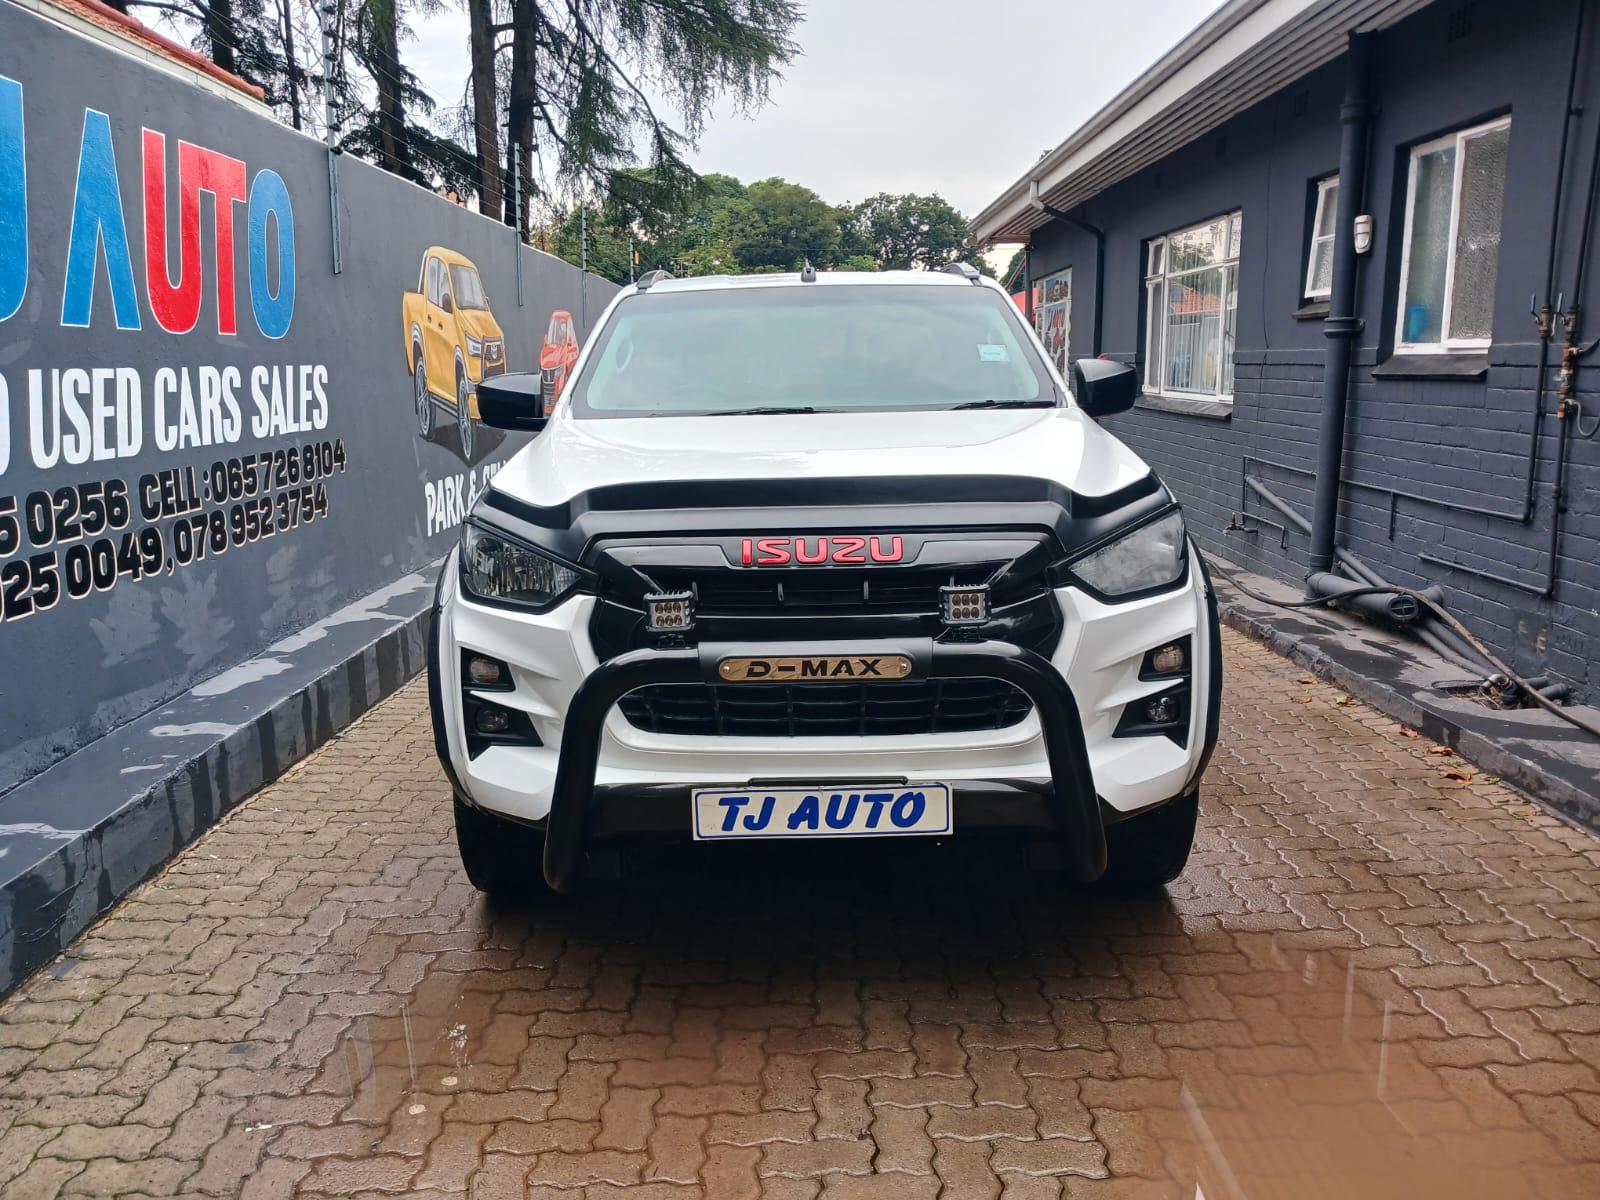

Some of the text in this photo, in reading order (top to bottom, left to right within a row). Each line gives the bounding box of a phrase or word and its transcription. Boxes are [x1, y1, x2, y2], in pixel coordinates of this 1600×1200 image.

[60, 107, 296, 339] AUTO
[28, 367, 143, 469] USED
[154, 365, 242, 451] CARS
[251, 364, 329, 438] SALES
[25, 478, 131, 548] 0256
[424, 473, 466, 536] PARK
[741, 536, 904, 565] ISUZU
[745, 658, 882, 678] D-MAX
[718, 791, 926, 832] TJ AUTO
